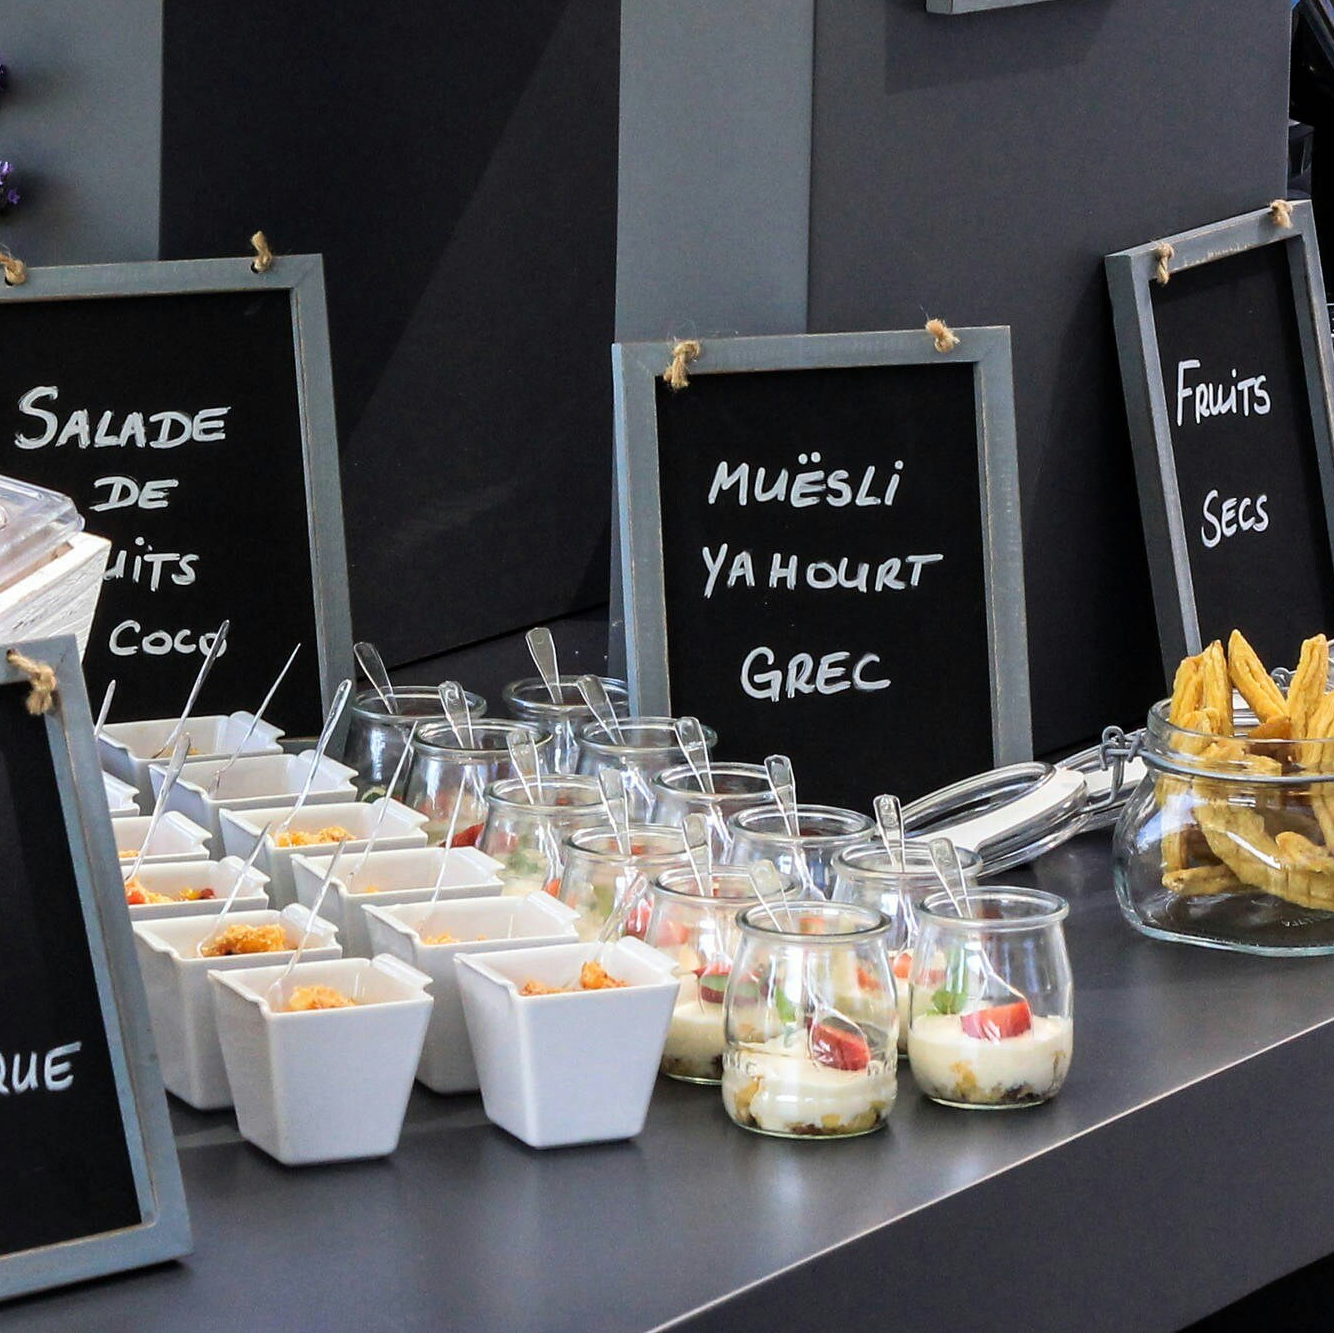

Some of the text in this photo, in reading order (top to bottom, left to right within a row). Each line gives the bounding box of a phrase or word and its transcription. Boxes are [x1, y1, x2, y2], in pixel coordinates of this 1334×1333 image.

[14, 385, 232, 450] SALADE
[89, 475, 179, 512] DE
[1201, 489, 1270, 549] SECS
[702, 542, 944, 599] YAHOURT
[108, 619, 230, 658] COCO
[740, 646, 892, 703] GREC
